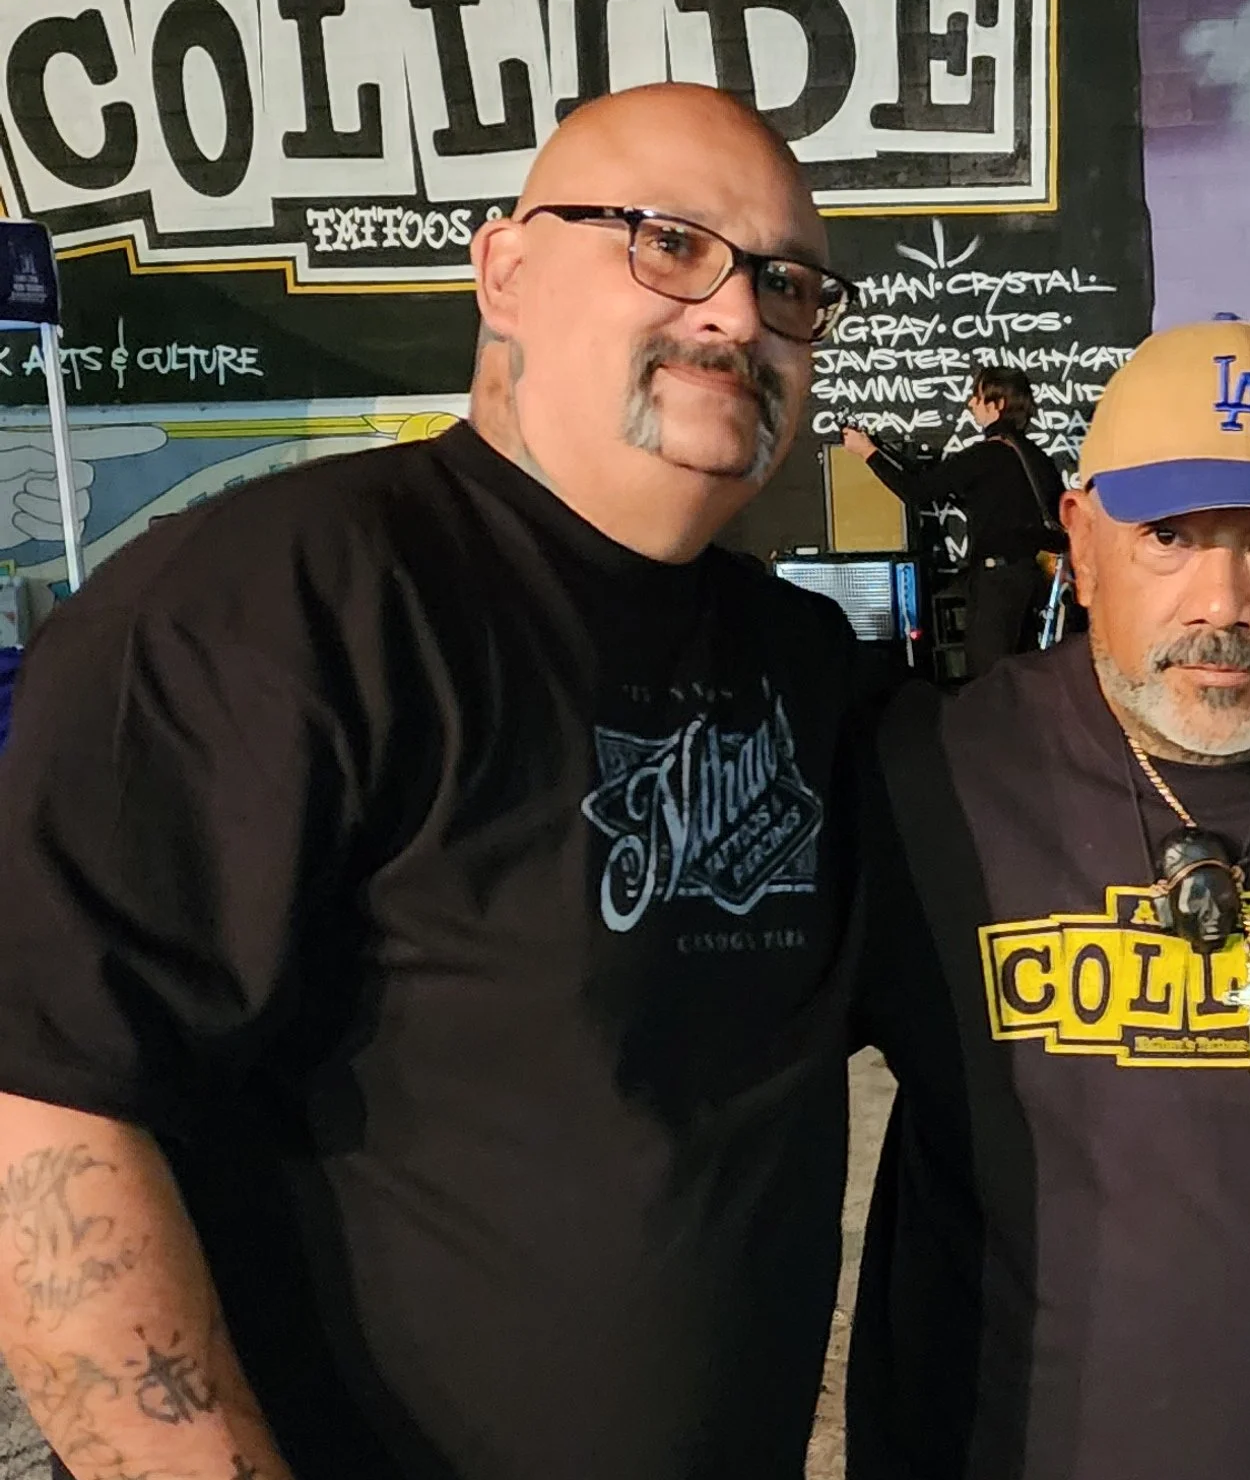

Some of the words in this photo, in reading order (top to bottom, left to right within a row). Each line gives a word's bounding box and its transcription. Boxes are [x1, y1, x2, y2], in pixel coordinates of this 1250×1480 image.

[305, 205, 473, 252] TATTOOS
[857, 272, 937, 309] THAN
[136, 341, 265, 386] CULTURE
